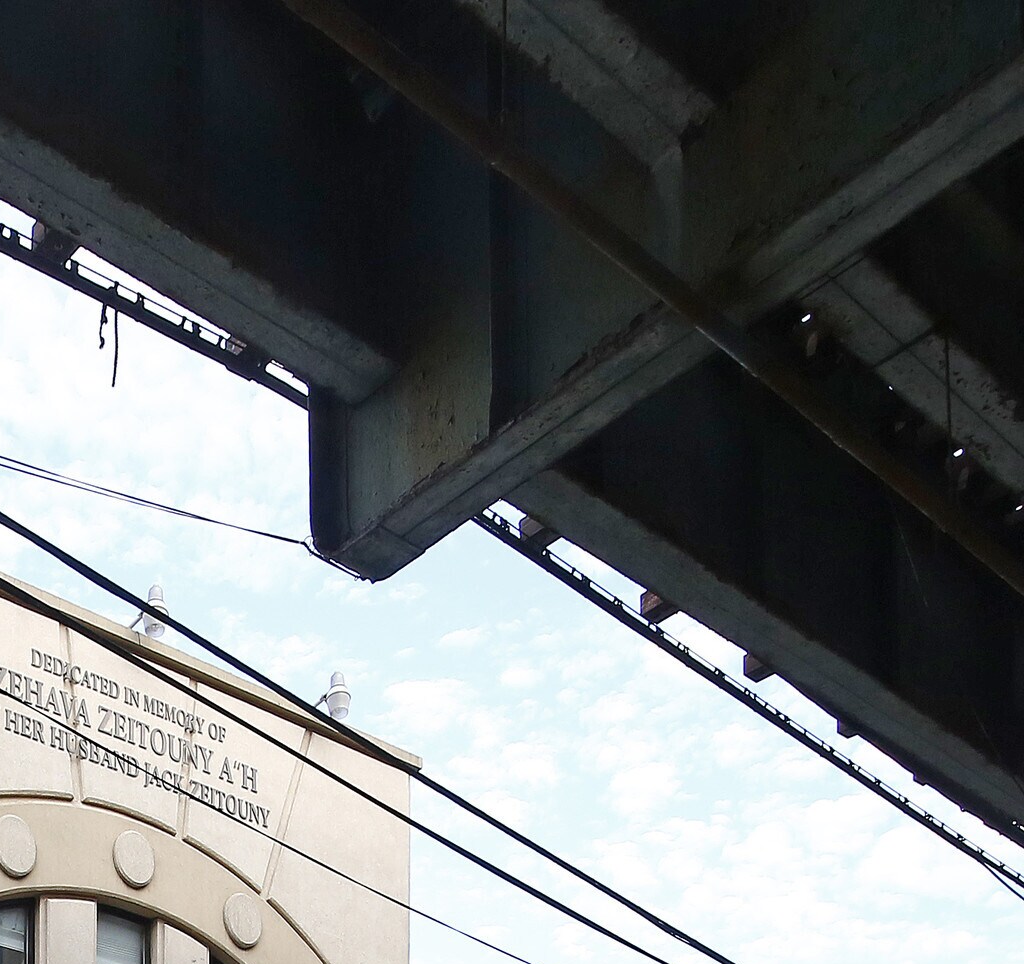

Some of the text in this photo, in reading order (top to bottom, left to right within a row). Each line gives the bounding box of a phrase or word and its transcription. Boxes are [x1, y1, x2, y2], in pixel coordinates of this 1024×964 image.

[31, 648, 226, 743] DEDICATED IN MEMORY OF
[98, 705, 214, 775] ZEITOUNY
[5, 709, 45, 744] HER
[50, 726, 139, 778] HUSBAND
[144, 762, 184, 794] JACK
[189, 779, 270, 828] ZEITOUNY
